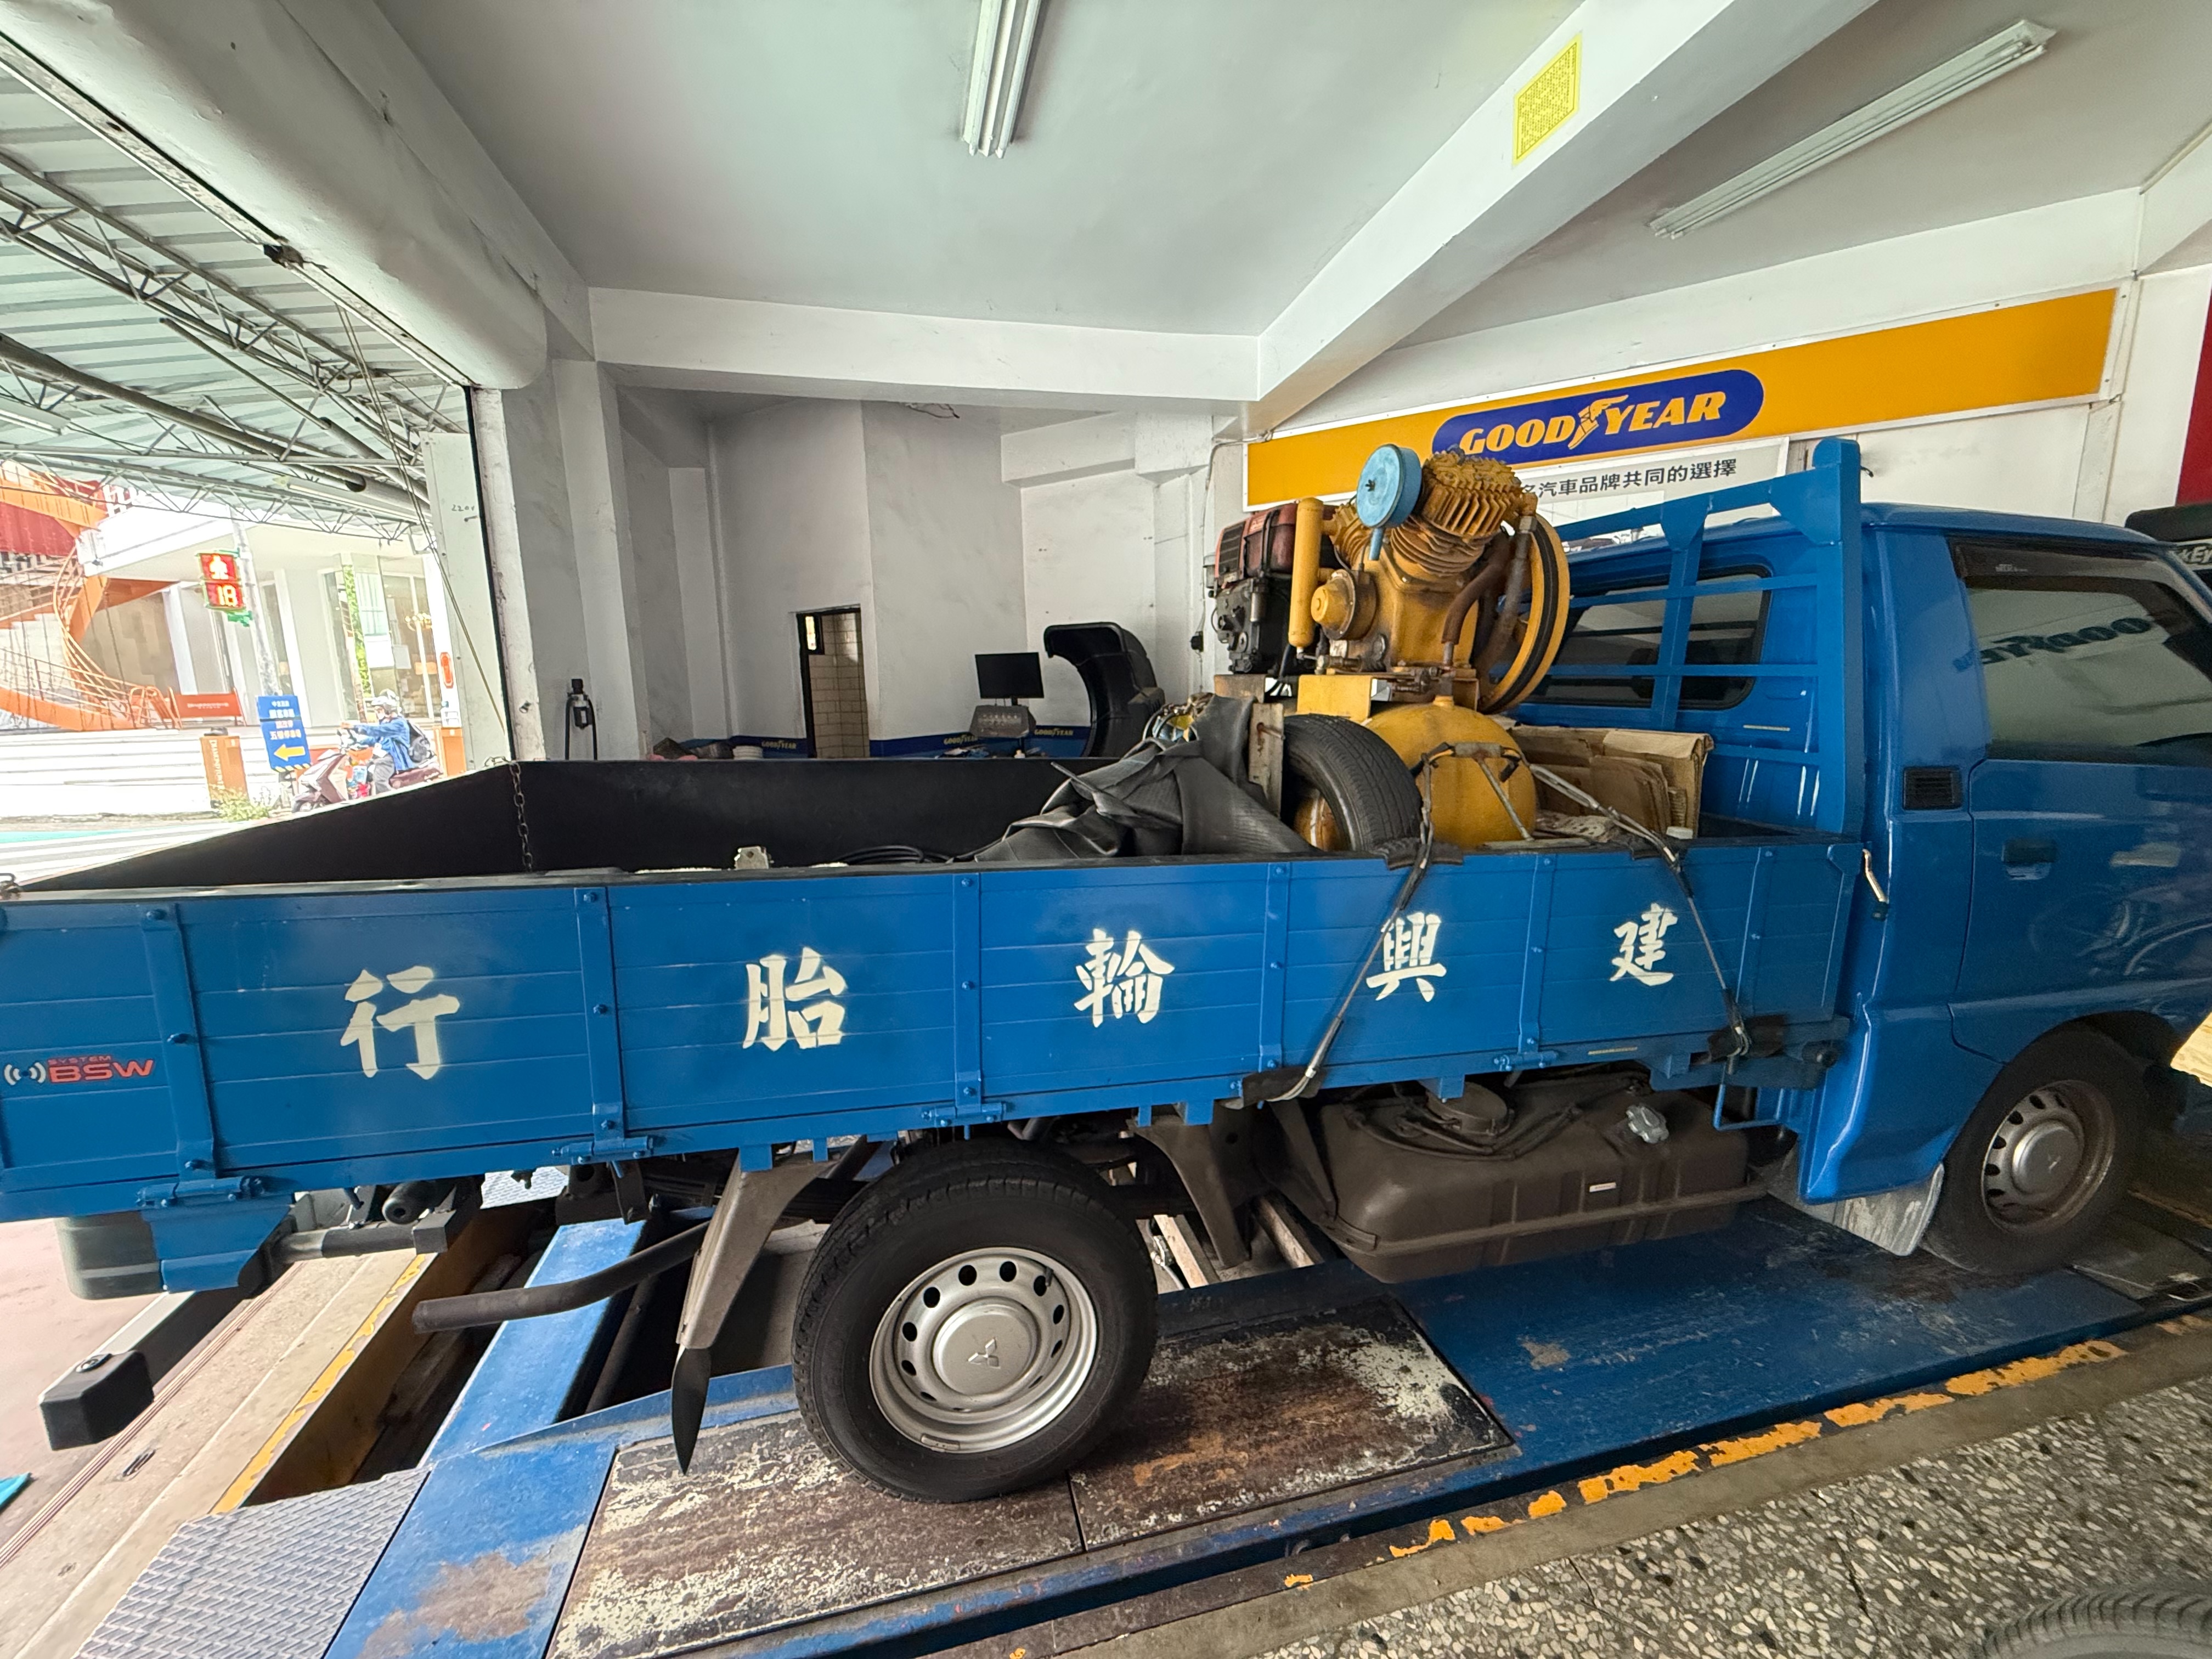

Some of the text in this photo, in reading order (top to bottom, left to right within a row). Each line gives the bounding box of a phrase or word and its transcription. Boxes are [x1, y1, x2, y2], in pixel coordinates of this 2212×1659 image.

[1458, 391, 1726, 455] GOODYEAR
[217, 584, 238, 607] 18
[340, 903, 1678, 1080] 建 興 輪 胎 行
[48, 1056, 111, 1065] SYSTEM
[49, 1059, 154, 1083] BSW
